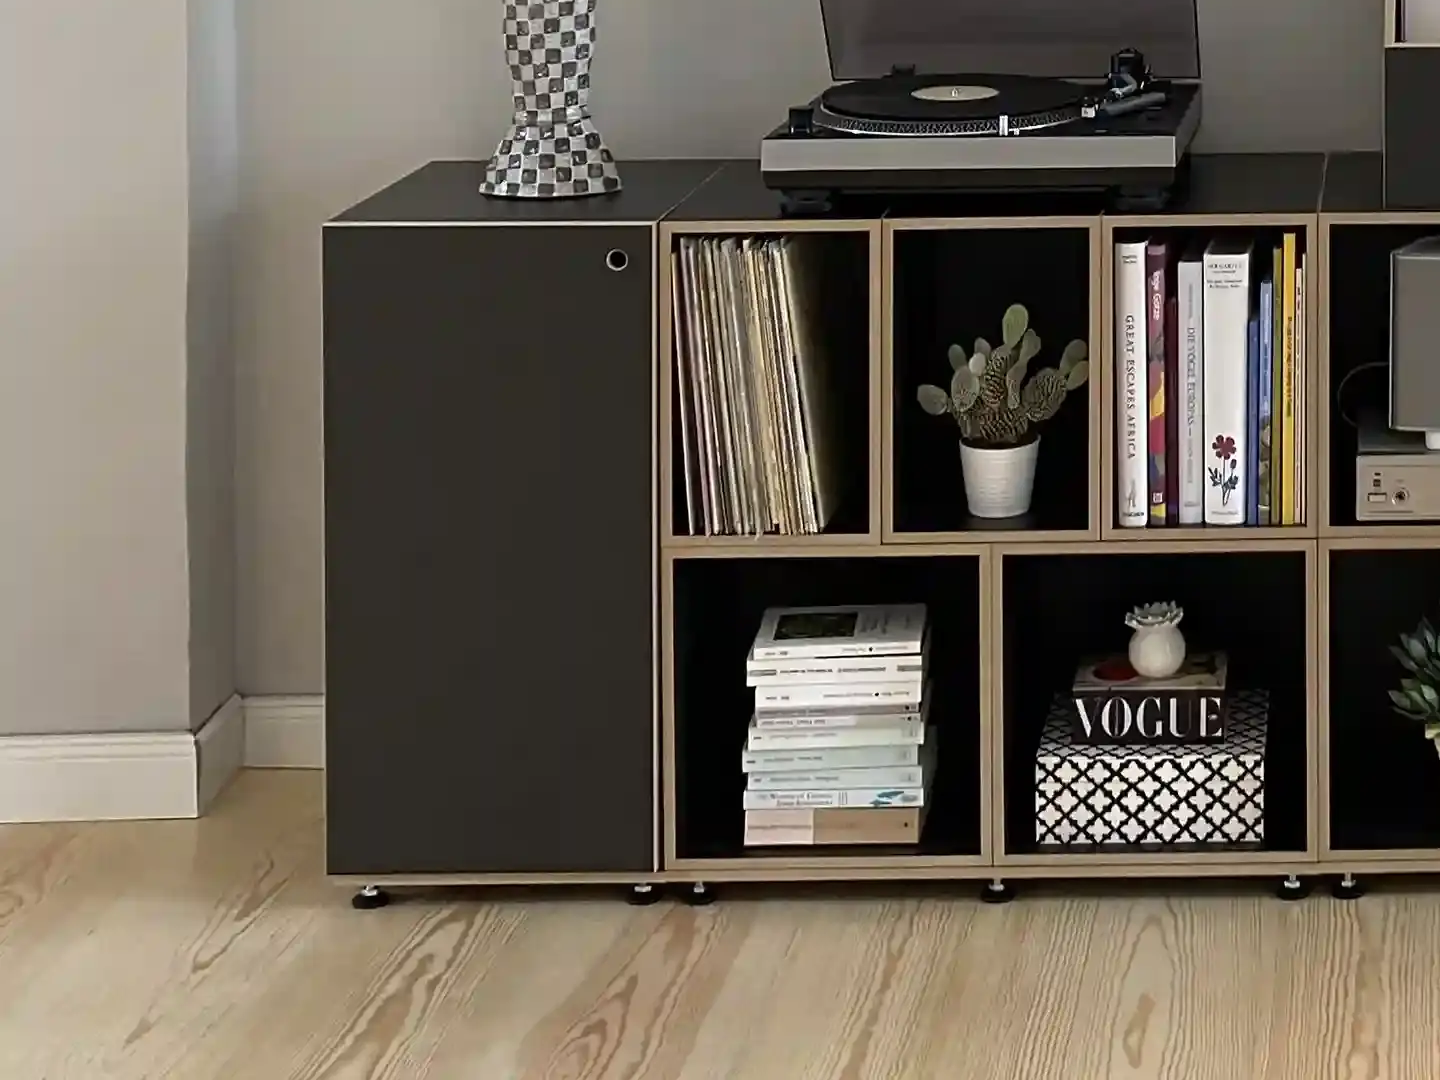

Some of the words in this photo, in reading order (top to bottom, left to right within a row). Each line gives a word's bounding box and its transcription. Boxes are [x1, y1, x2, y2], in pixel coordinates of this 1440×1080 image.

[1125, 315, 1135, 354] GREAT
[1126, 359, 1136, 409] ESCAPES
[1127, 414, 1136, 459] AFRICA
[1074, 697, 1223, 738] VOGUE
